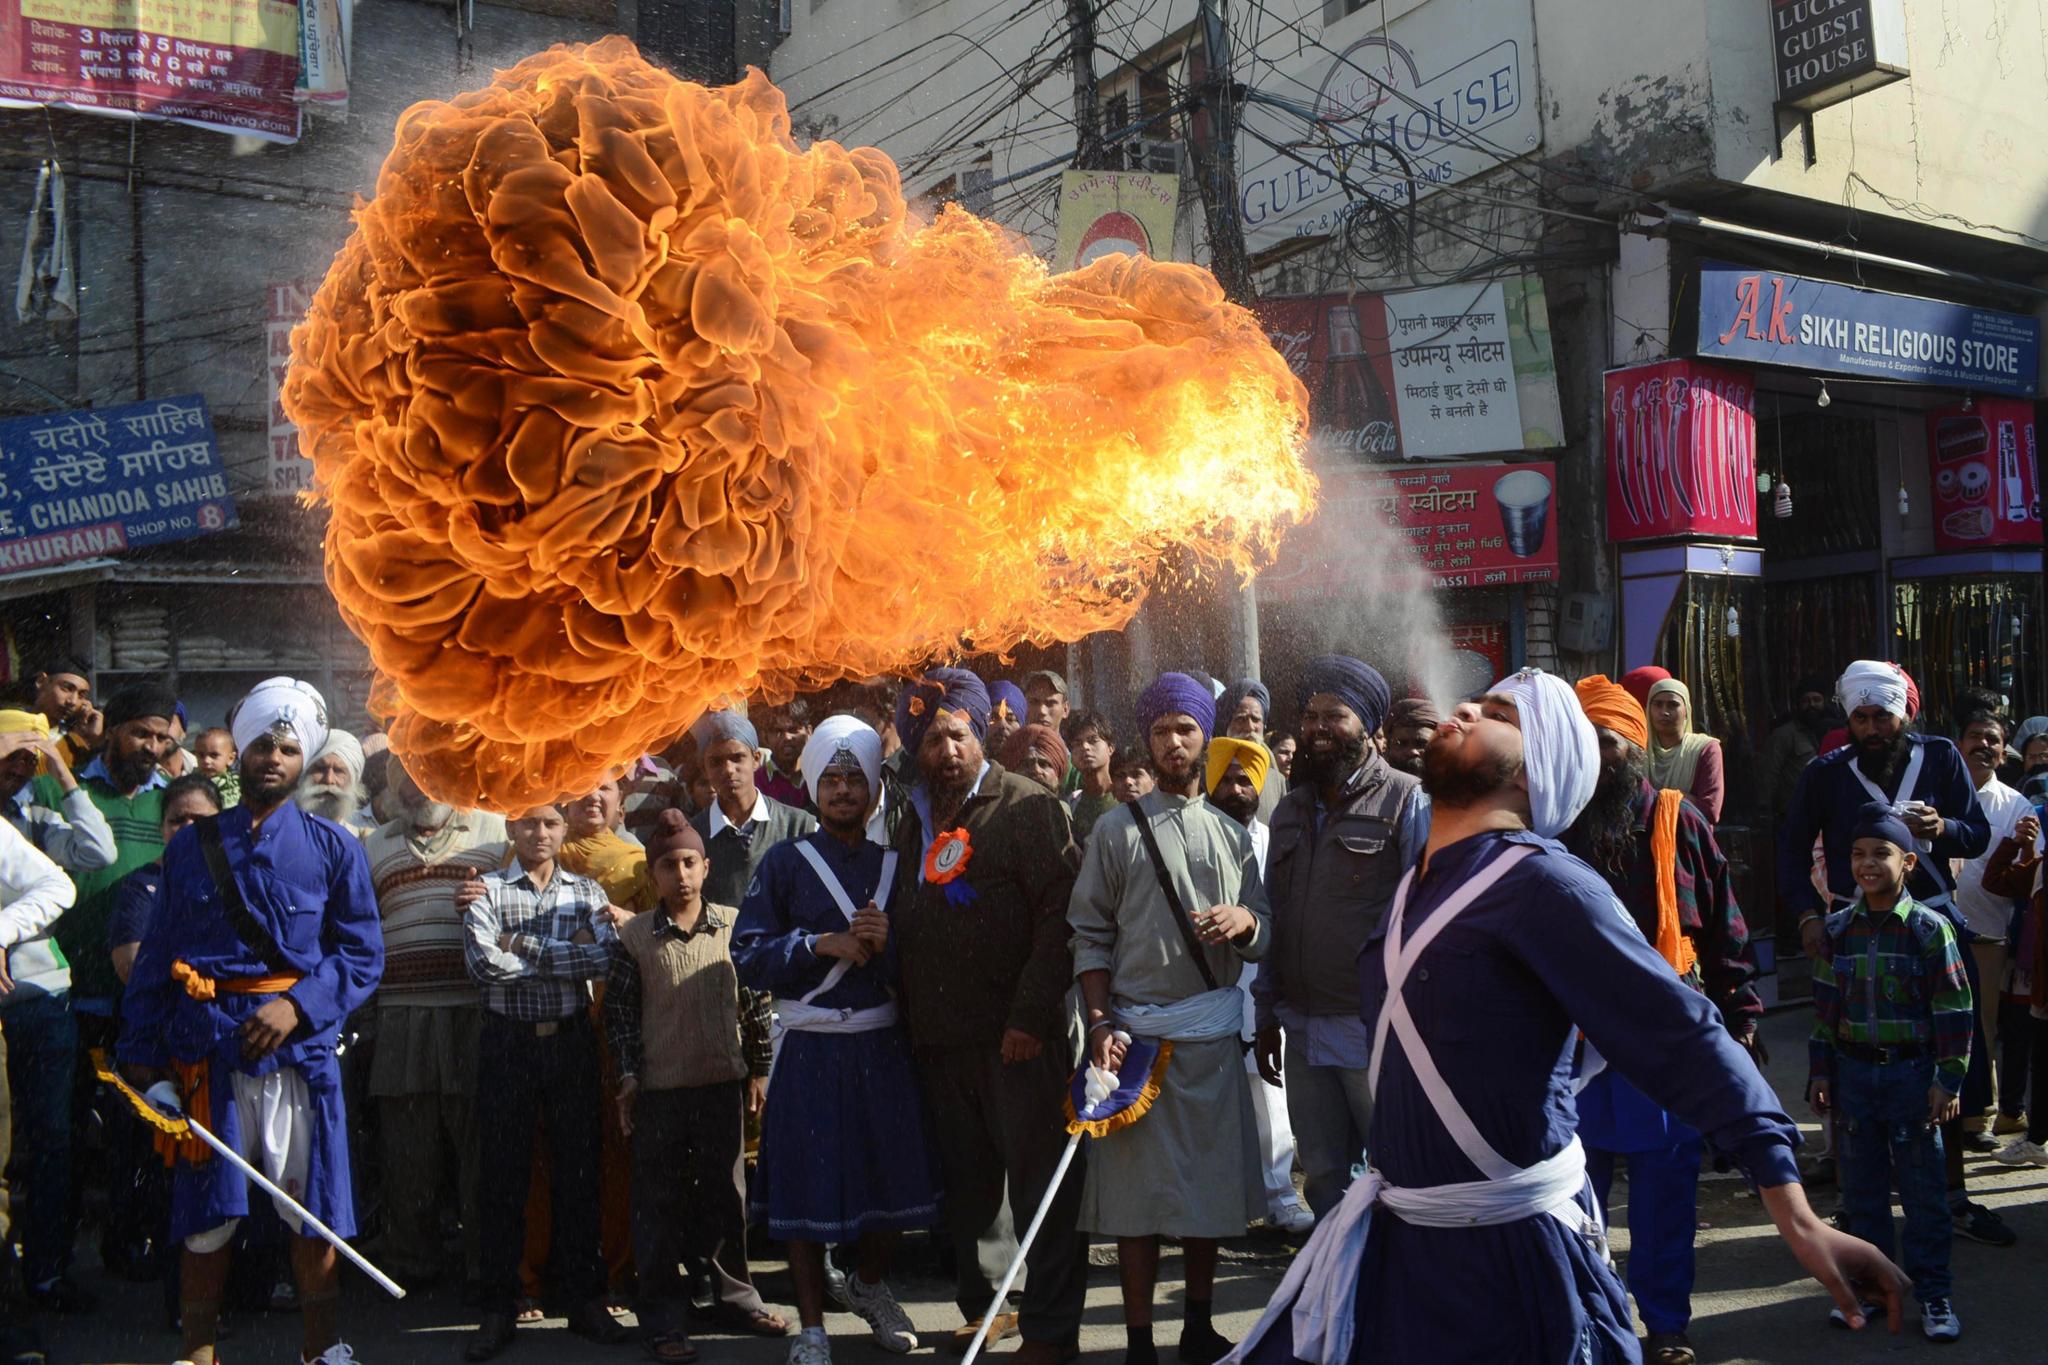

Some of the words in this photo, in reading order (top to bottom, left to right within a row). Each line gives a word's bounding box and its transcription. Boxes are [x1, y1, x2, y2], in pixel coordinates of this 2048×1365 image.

[79, 28, 94, 44] 3
[156, 37, 170, 52] 5
[1783, 8, 1862, 57] GUEST
[108, 48, 121, 62] 3
[167, 55, 181, 71] 6
[1785, 38, 1868, 88] HOUSE
[159, 104, 291, 133] www.shivyog.com
[1366, 65, 1515, 172] HOUSE
[1318, 214, 1328, 230] &
[1399, 313, 1427, 336] पुरानी
[1465, 313, 1496, 332] दुकान
[1396, 344, 1455, 374] उपमन्यू
[1456, 335, 1505, 364] स्वीटस
[1800, 313, 1848, 350] SIKH
[1854, 322, 1957, 365] RELIGIOUS
[1961, 339, 2019, 375] STORE
[1839, 353, 1887, 369] Manufactures
[1887, 361, 1893, 369] &
[1894, 361, 1928, 374] Exporters
[1928, 366, 1953, 377] Swords
[1959, 370, 1984, 382] Musical
[1405, 381, 1439, 400] मिठाई
[1466, 378, 1490, 397] देसी
[1493, 377, 1507, 393] घी
[121, 403, 206, 438] साहिब
[1430, 404, 1441, 420] से
[1446, 402, 1474, 418] बनती
[1478, 400, 1489, 417] है
[117, 439, 211, 478] ਸਾਹਿਬ
[30, 487, 151, 530] CHANDOA
[155, 473, 227, 508] SAHIB
[1407, 485, 1479, 515] स्वीटस
[0, 526, 124, 570] KHURANA
[127, 520, 167, 538] SHOP
[204, 505, 221, 529] 8
[1432, 575, 1468, 588] LASSI
